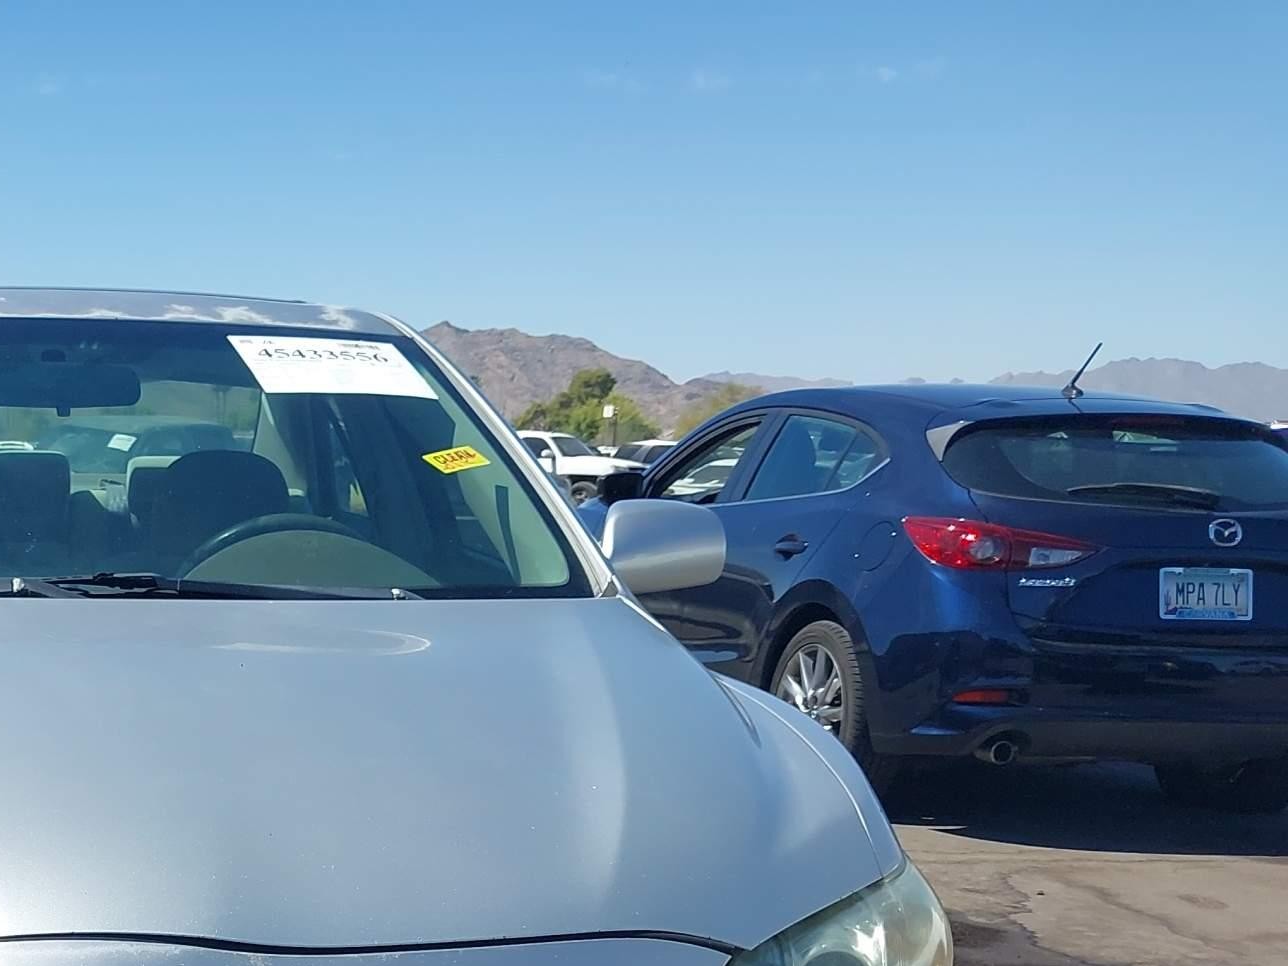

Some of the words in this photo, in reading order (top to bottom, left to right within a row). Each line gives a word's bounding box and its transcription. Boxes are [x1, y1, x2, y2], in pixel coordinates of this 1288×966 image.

[258, 348, 389, 363] 45433556
[1175, 582, 1206, 606] MPA
[1212, 582, 1241, 607] 7LY
